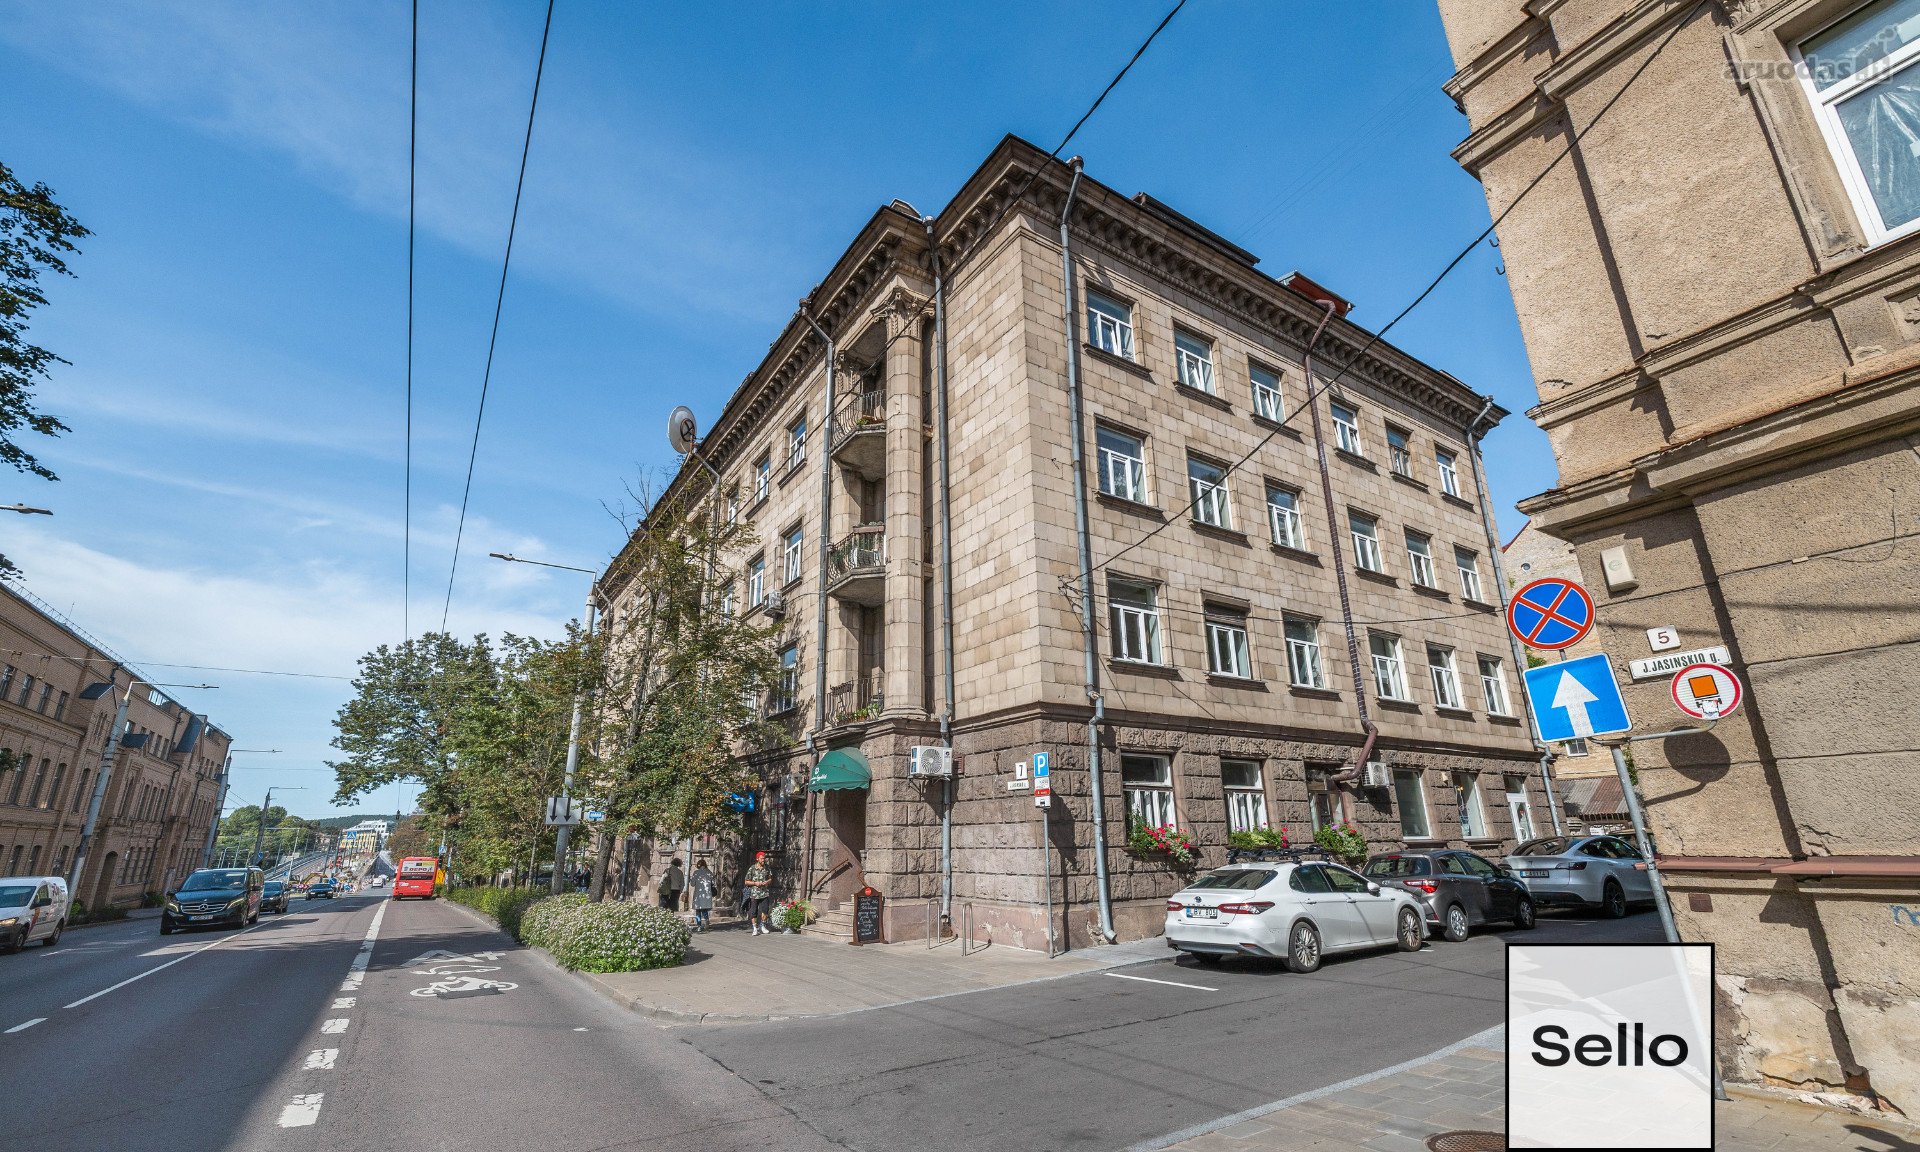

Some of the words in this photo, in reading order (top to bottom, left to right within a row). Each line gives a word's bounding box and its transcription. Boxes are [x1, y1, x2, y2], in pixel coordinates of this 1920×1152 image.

[1657, 631, 1670, 644] 5
[1018, 764, 1024, 777] 7
[1037, 755, 1046, 775] P
